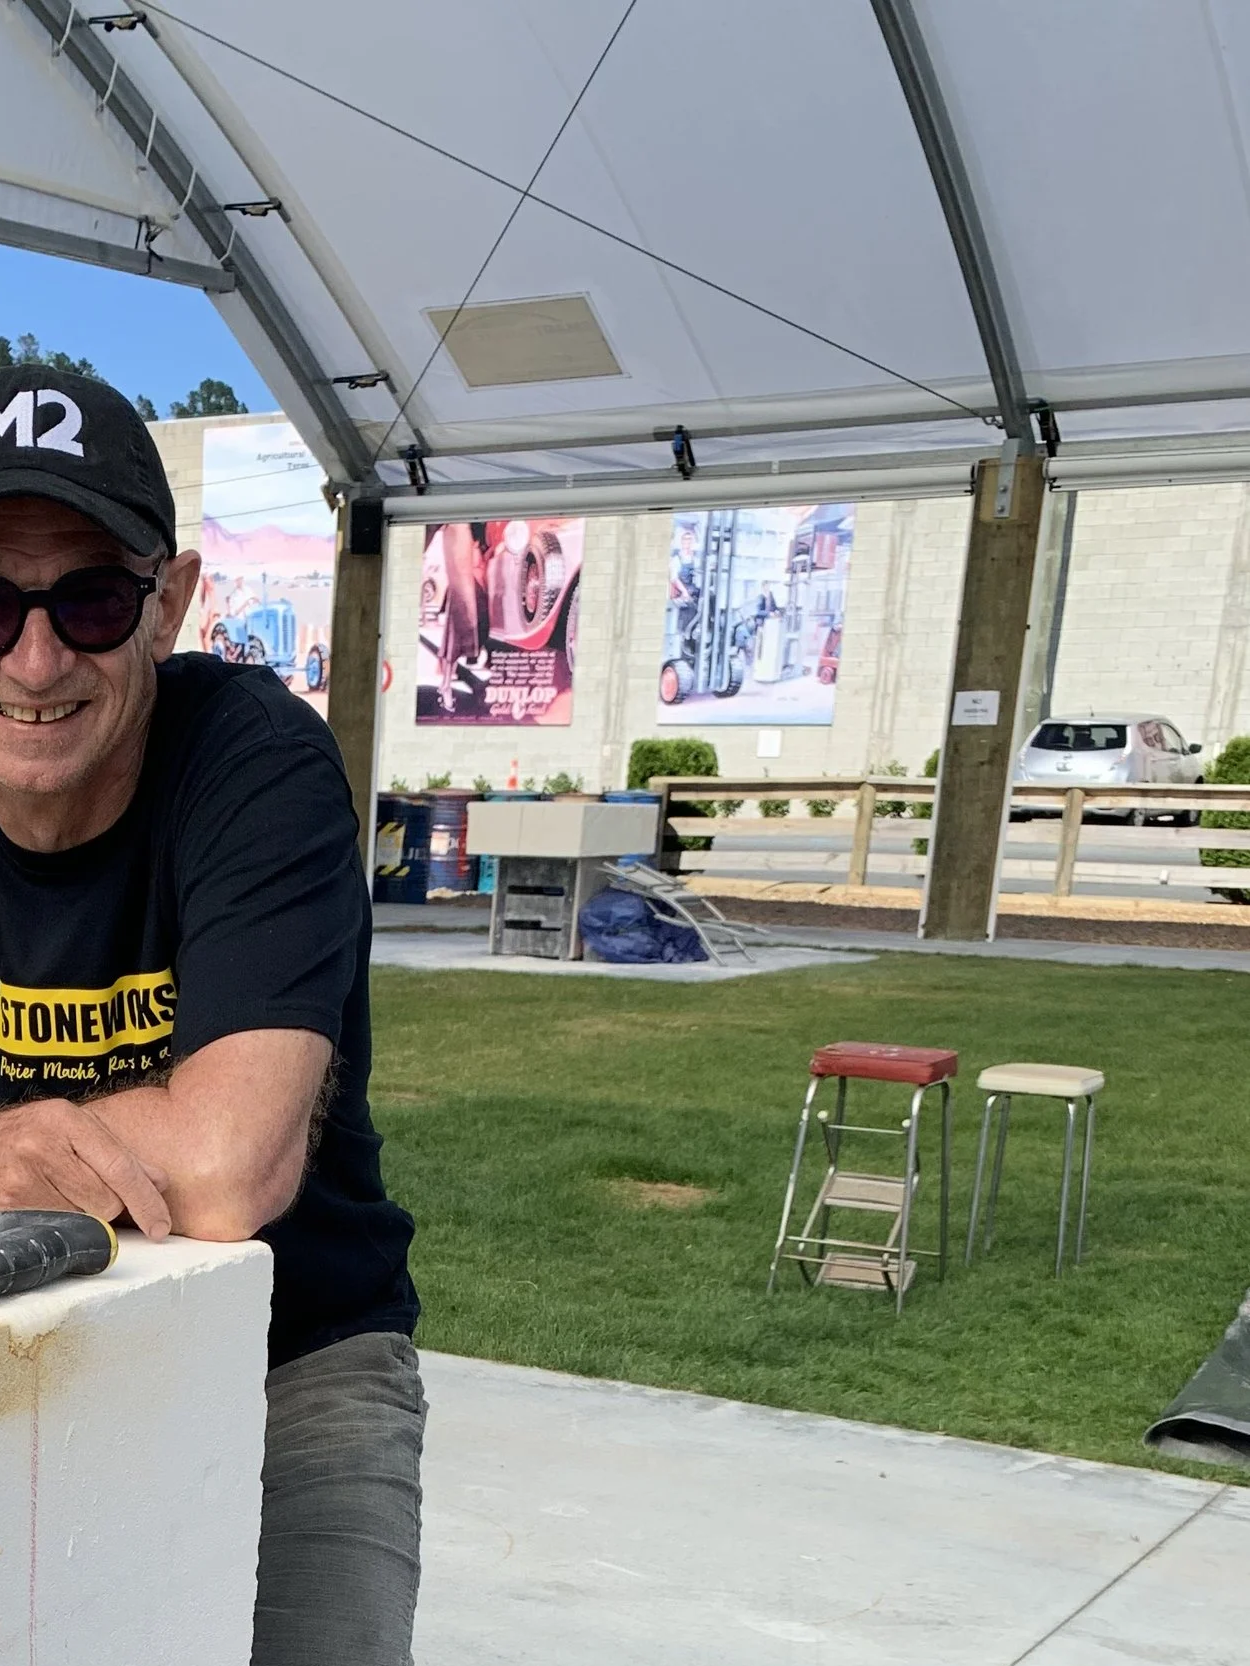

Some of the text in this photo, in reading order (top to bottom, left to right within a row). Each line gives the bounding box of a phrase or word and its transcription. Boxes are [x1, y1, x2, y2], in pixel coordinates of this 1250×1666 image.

[256, 452, 305, 463] Agricultural
[484, 686, 558, 707] DUNLOP
[0, 983, 178, 1043] STONEWOKS
